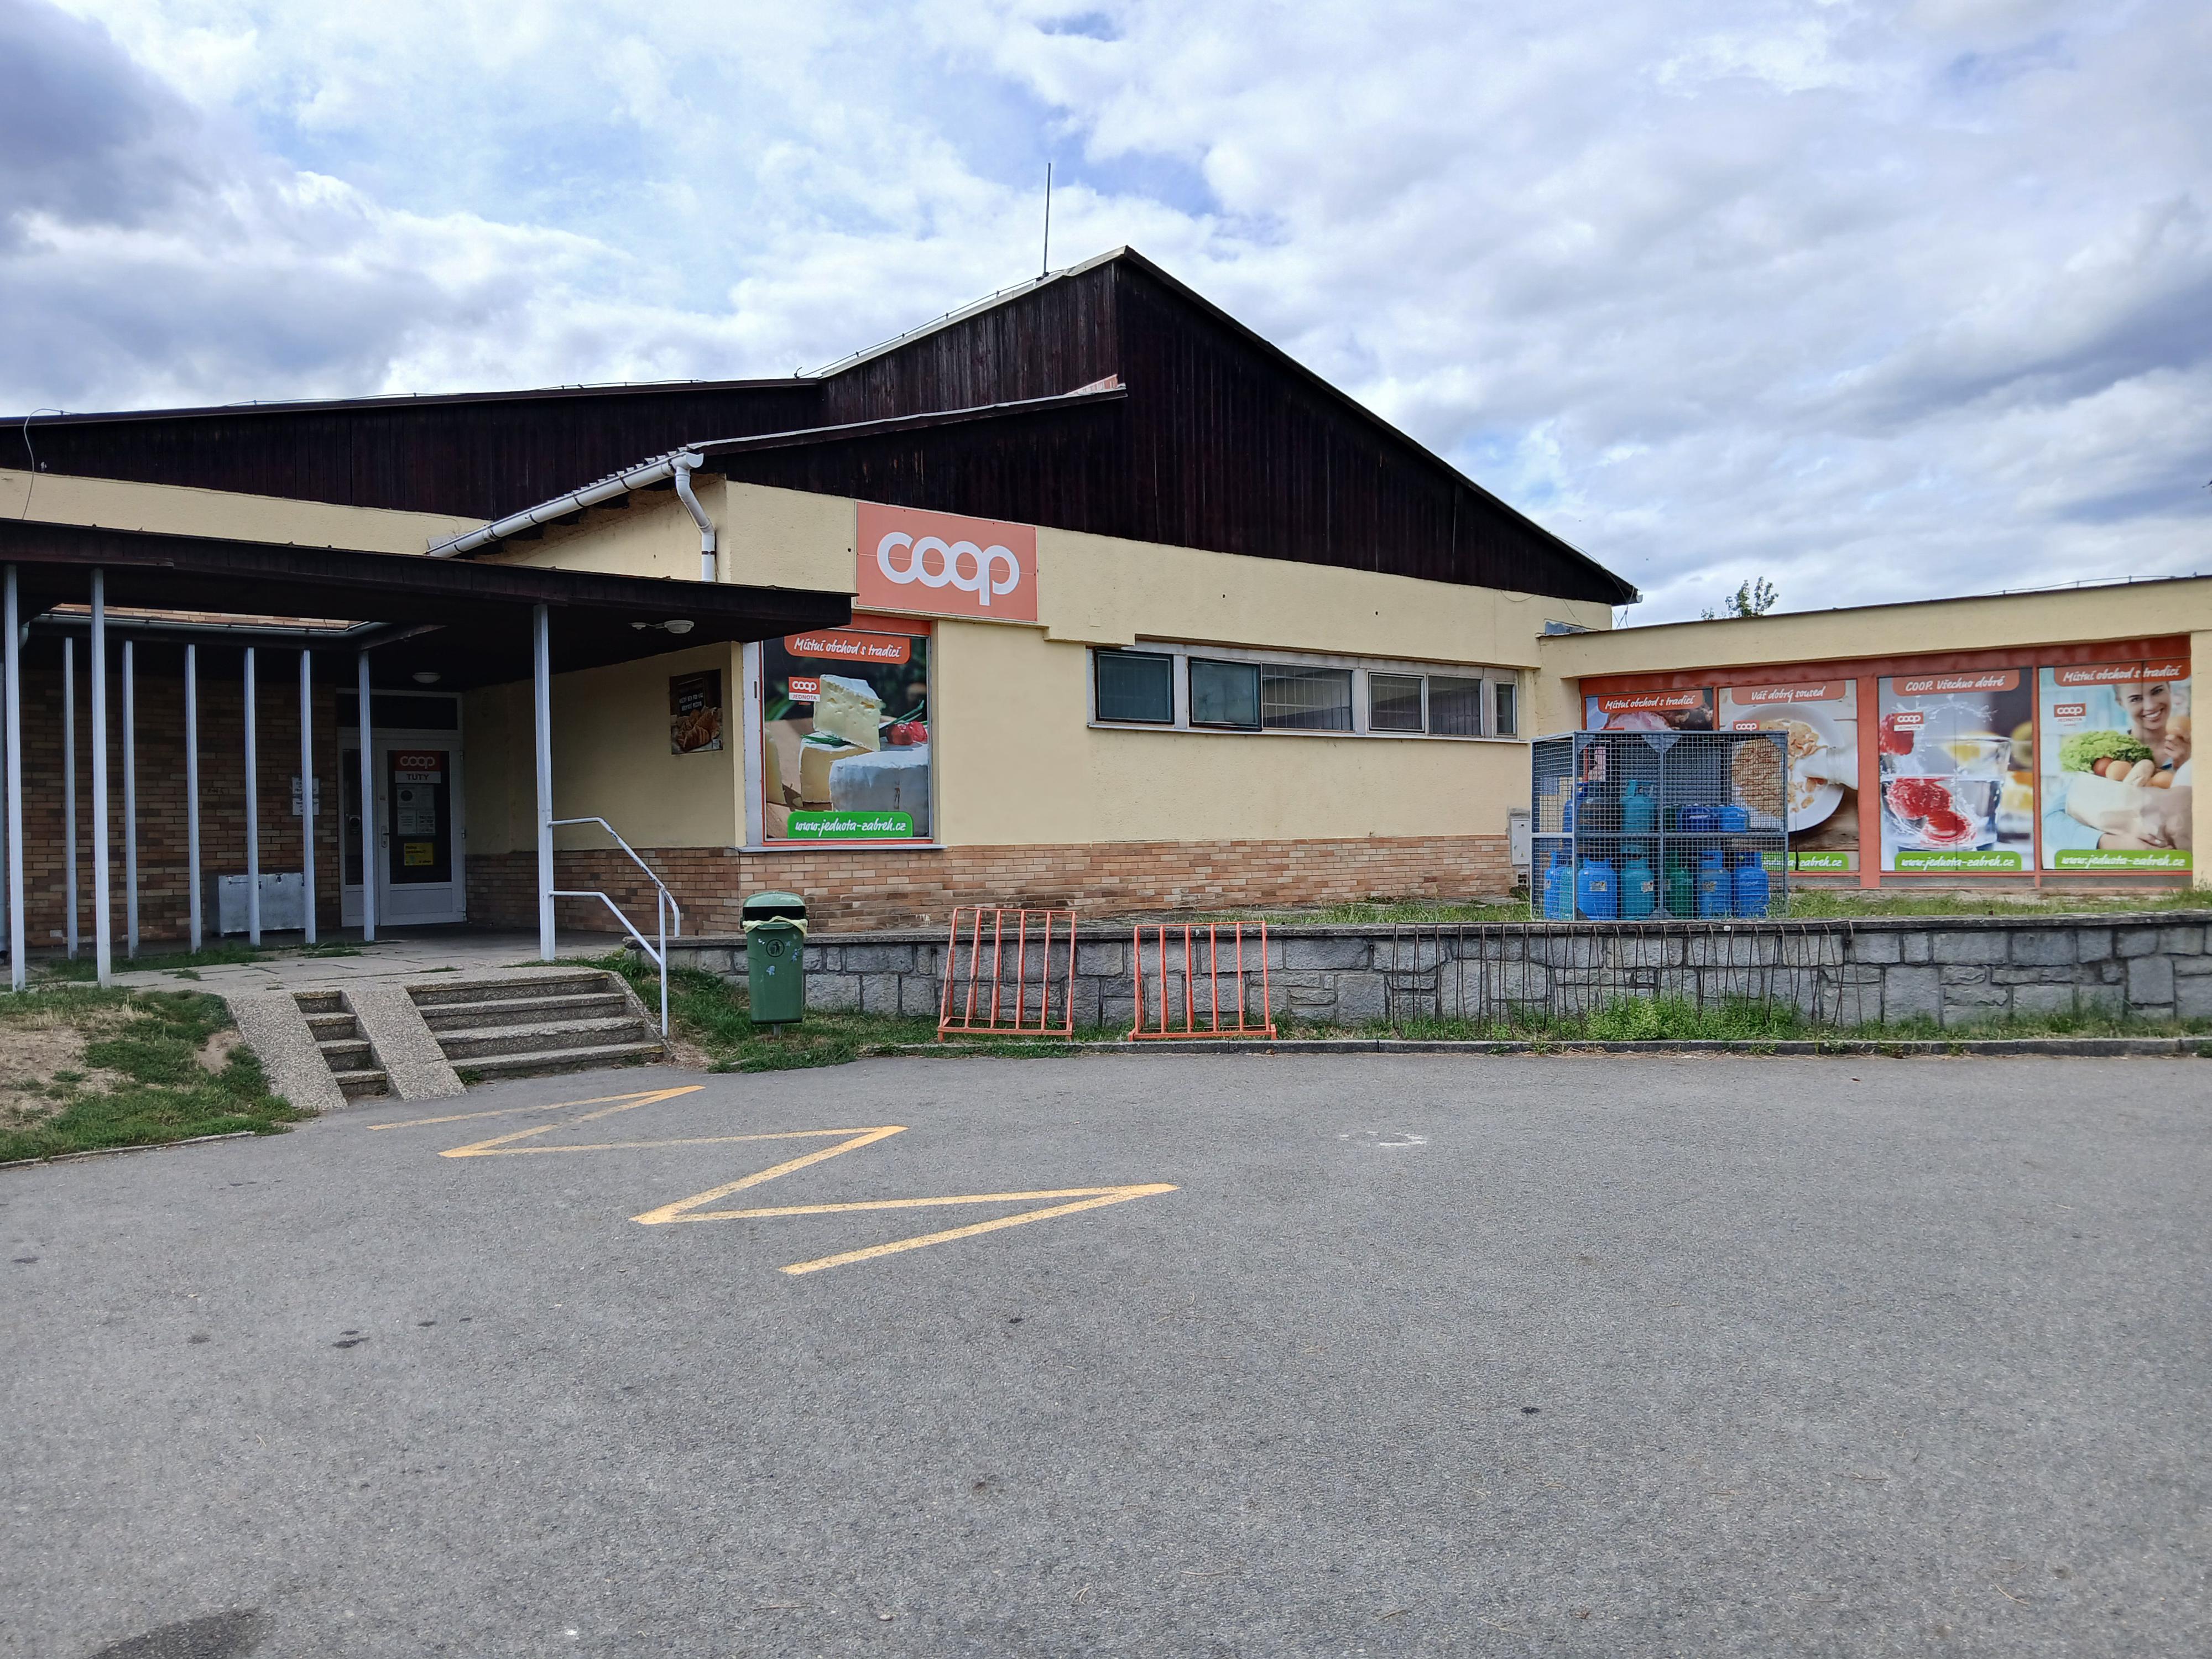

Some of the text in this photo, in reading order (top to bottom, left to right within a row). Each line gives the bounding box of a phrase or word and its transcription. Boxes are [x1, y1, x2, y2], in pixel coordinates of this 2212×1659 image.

[877, 532, 1020, 606] coop
[794, 637, 902, 658] Místní obchod s tradicí
[2062, 665, 2182, 682] Místní obchod s tradicí
[792, 681, 817, 692] coop
[1905, 675, 2006, 691] COOP. Všechno dobré
[1605, 699, 1630, 709] Místní
[1631, 696, 1660, 707] obchod
[1666, 695, 1695, 705] tradicí
[1751, 686, 1826, 703] Váš dobrý soused
[2057, 706, 2083, 715] coop
[1735, 723, 1757, 731] coop
[1897, 715, 1921, 723] coop
[795, 817, 906, 837] www.jednota-zabreh.cz
